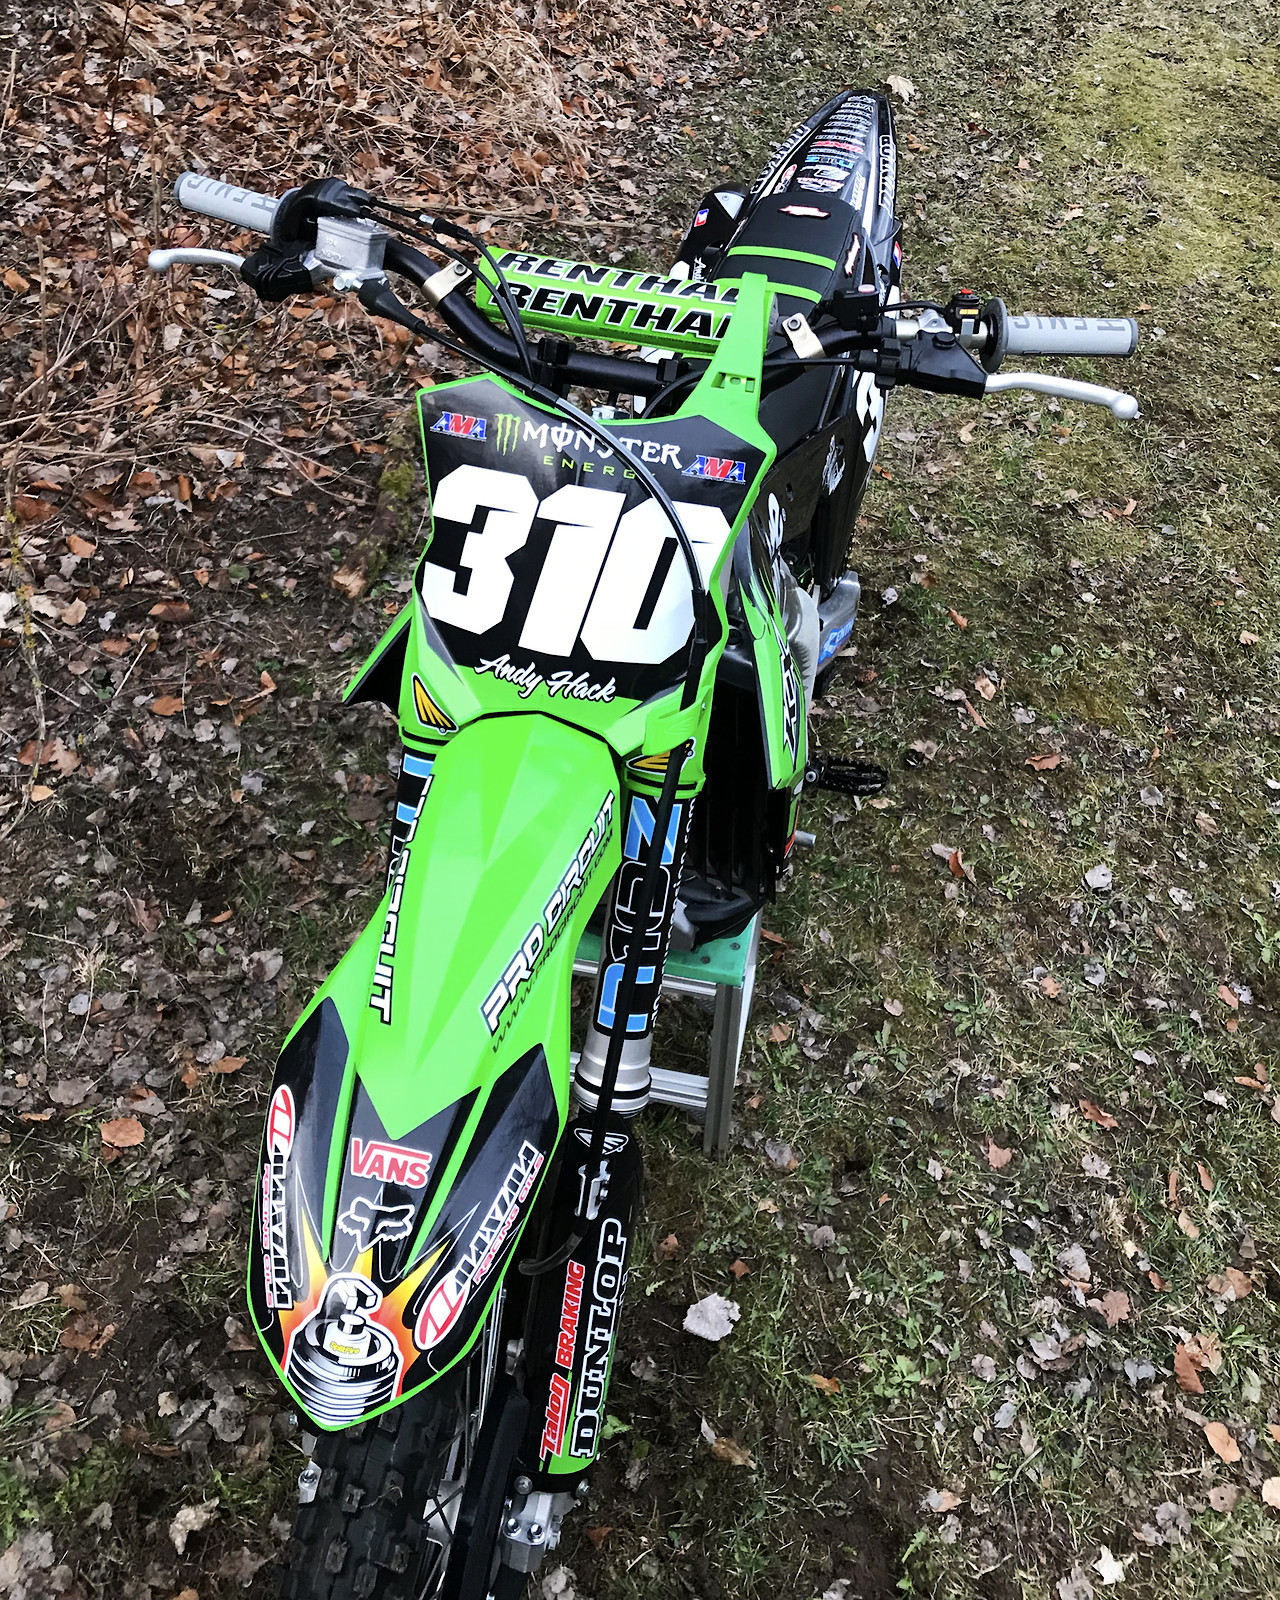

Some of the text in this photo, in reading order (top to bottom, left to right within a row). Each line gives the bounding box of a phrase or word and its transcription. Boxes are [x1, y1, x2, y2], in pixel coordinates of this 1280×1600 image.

[430, 411, 487, 442] AMA
[543, 455, 656, 480] ENERG
[681, 454, 747, 484] AMA
[421, 464, 733, 665] 310
[474, 653, 617, 702] Andy Hack
[480, 789, 616, 1036] PRO CIRCUIT
[350, 1137, 433, 1188] VANS
[518, 1152, 545, 1204] OILS
[538, 1259, 586, 1461] Talon BRAKING
[570, 1217, 627, 1459] DUNLOP
